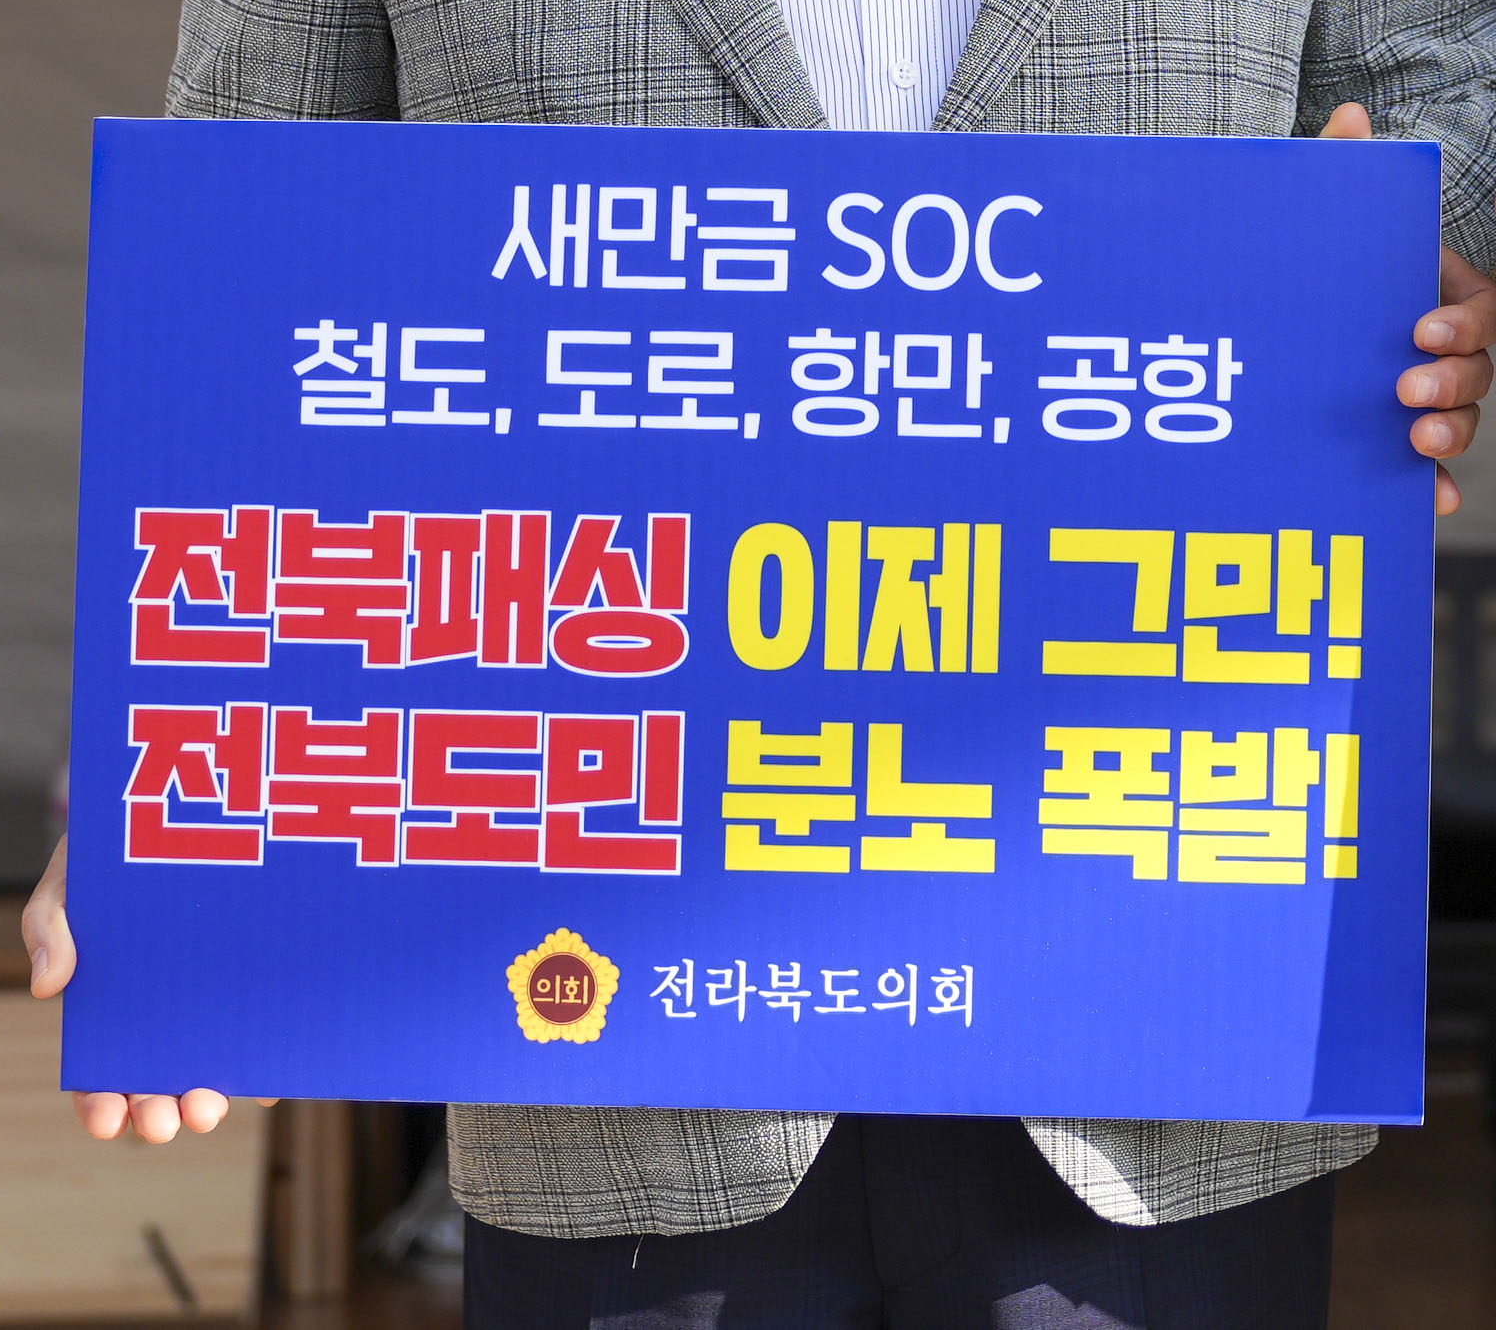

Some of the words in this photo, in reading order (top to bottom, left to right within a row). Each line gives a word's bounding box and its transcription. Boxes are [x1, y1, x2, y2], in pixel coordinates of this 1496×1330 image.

[490, 182, 796, 292] 새만금
[821, 192, 1045, 293] SOC
[292, 319, 513, 435] 철도,
[537, 329, 761, 440] 도로,
[787, 327, 1011, 444] 항만,
[1037, 334, 1244, 444] 공항
[127, 504, 692, 679] 전북패싱
[726, 520, 1003, 674] 이제
[1041, 527, 1364, 685] 그만!
[121, 700, 686, 876] 전북도민
[721, 719, 996, 874] 분노
[1037, 726, 1361, 886] 폭발!
[532, 974, 590, 1006] 의회
[648, 958, 975, 1028] 전라북도의회
